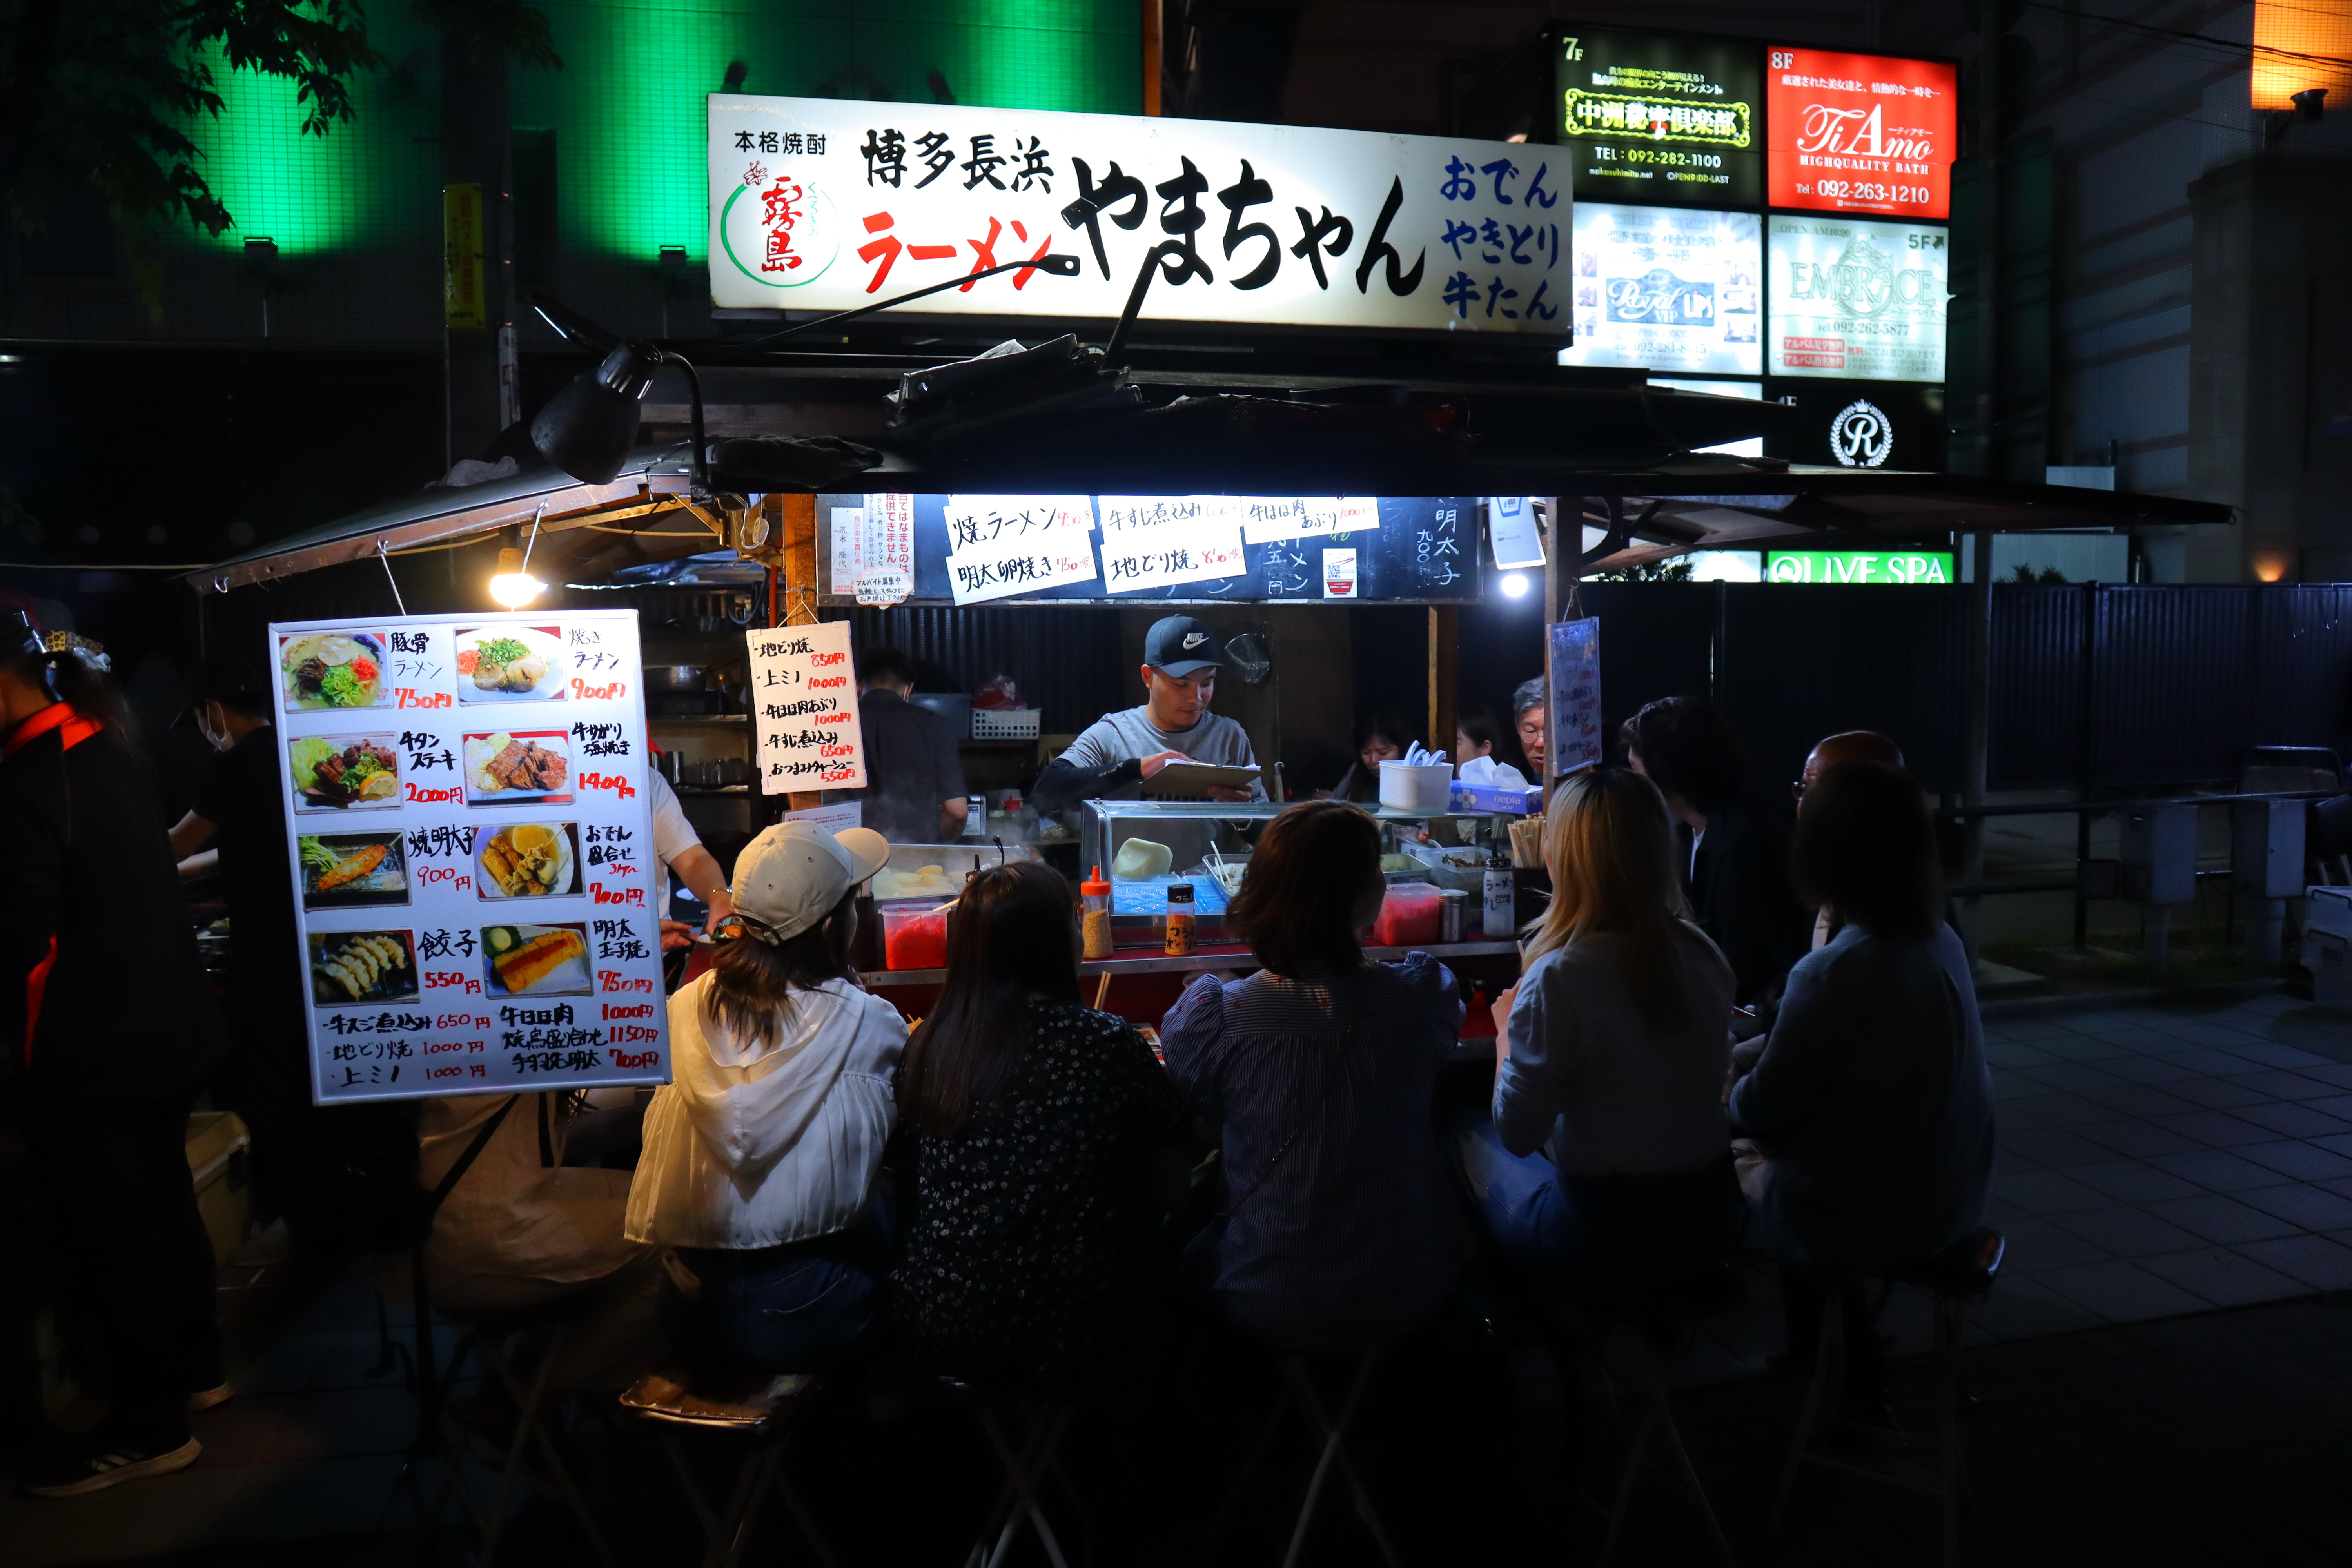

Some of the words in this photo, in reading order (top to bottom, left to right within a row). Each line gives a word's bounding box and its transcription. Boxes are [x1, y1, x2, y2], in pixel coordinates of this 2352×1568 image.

[1563, 37, 1584, 61] 7F
[1771, 51, 1794, 69] 8F
[735, 130, 826, 155] 本格焼酎
[860, 128, 1054, 194] 博多長浜
[1627, 149, 1722, 168] 092-282-1100
[1896, 162, 1929, 175] BATH
[1440, 154, 1559, 209] おでん
[1817, 179, 1930, 204] 092-263-1210
[761, 176, 803, 274] 霧島
[1070, 154, 1426, 297] やまちゃん
[1780, 223, 1809, 234] OPEN
[857, 210, 1052, 294] ラーメン
[1440, 216, 1559, 270] やきとり
[1909, 234, 1931, 249] 5F
[1441, 270, 1559, 321] 牛たん
[1790, 262, 1937, 308] EMBRACE
[1608, 279, 1687, 319] Royal
[1684, 291, 1715, 319] LIPS
[1654, 310, 1679, 323] VIP
[1844, 413, 1882, 457] R
[1109, 501, 1202, 531] 牛すじ煮込み
[1301, 512, 1337, 530] あぶり
[886, 493, 896, 563] 提供できません
[953, 508, 1056, 551] 焼ラーメン
[1433, 508, 1462, 586] 明太子
[957, 556, 1052, 593] 明太卵焼き
[1110, 549, 1199, 581] 地どり焼
[1887, 557, 1947, 583] SPA
[857, 576, 901, 586] アルバイト募集中
[391, 632, 429, 655] 豚骨
[568, 628, 602, 646] 焼き
[1187, 633, 1204, 642] NIKE
[394, 660, 443, 679] ラーメン
[574, 651, 619, 670] ラーメン
[810, 652, 845, 668] 850円
[571, 678, 626, 700] 900円
[808, 676, 847, 690] 1000円
[394, 688, 452, 709] 750円
[815, 712, 851, 727] 1000円
[399, 730, 440, 751] 牛タン
[583, 740, 630, 757] 塩焼き
[820, 744, 854, 757] 650円
[409, 749, 457, 771] ステーキ
[578, 772, 635, 800] 1400円
[821, 768, 856, 783] 550円
[405, 782, 463, 805] 2000円
[1494, 795, 1521, 804] nepia
[408, 823, 473, 858] 焼明太子
[585, 824, 633, 843] おでん
[587, 845, 636, 866] 盛合せ
[417, 866, 472, 891] 900円
[593, 918, 637, 941] 明太
[417, 928, 478, 962] 餃子
[425, 971, 481, 995] 550円
[597, 969, 653, 994] 750円
[436, 1013, 491, 1031] 650円
[601, 1003, 654, 1021] 1000円
[423, 1040, 485, 1056] 1000円
[502, 1027, 609, 1051] 焼鳥盛り合わせ
[609, 1026, 659, 1044] 1150円
[425, 1064, 487, 1081] 1000円
[512, 1049, 602, 1074] 手羽先明太
[608, 1048, 659, 1069] 700円
